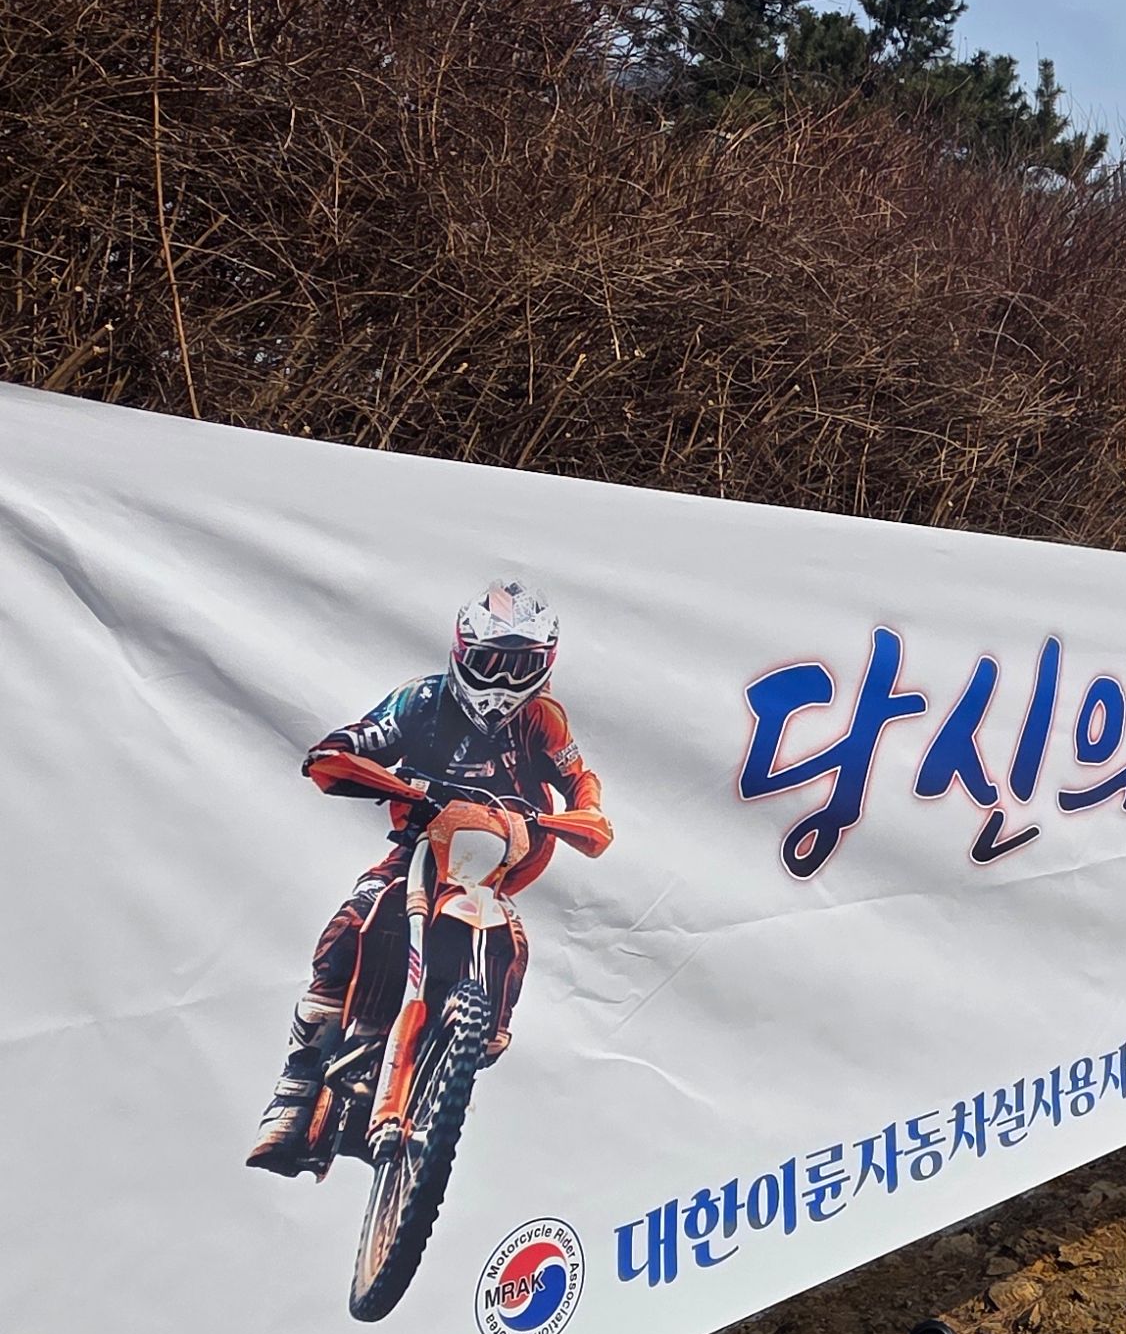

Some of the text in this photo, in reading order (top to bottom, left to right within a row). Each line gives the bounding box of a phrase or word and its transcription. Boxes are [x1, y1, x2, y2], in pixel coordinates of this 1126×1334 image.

[487, 1224, 553, 1279] Motorcycle
[554, 1227, 576, 1258] Rider
[485, 1271, 544, 1309] MRAK
